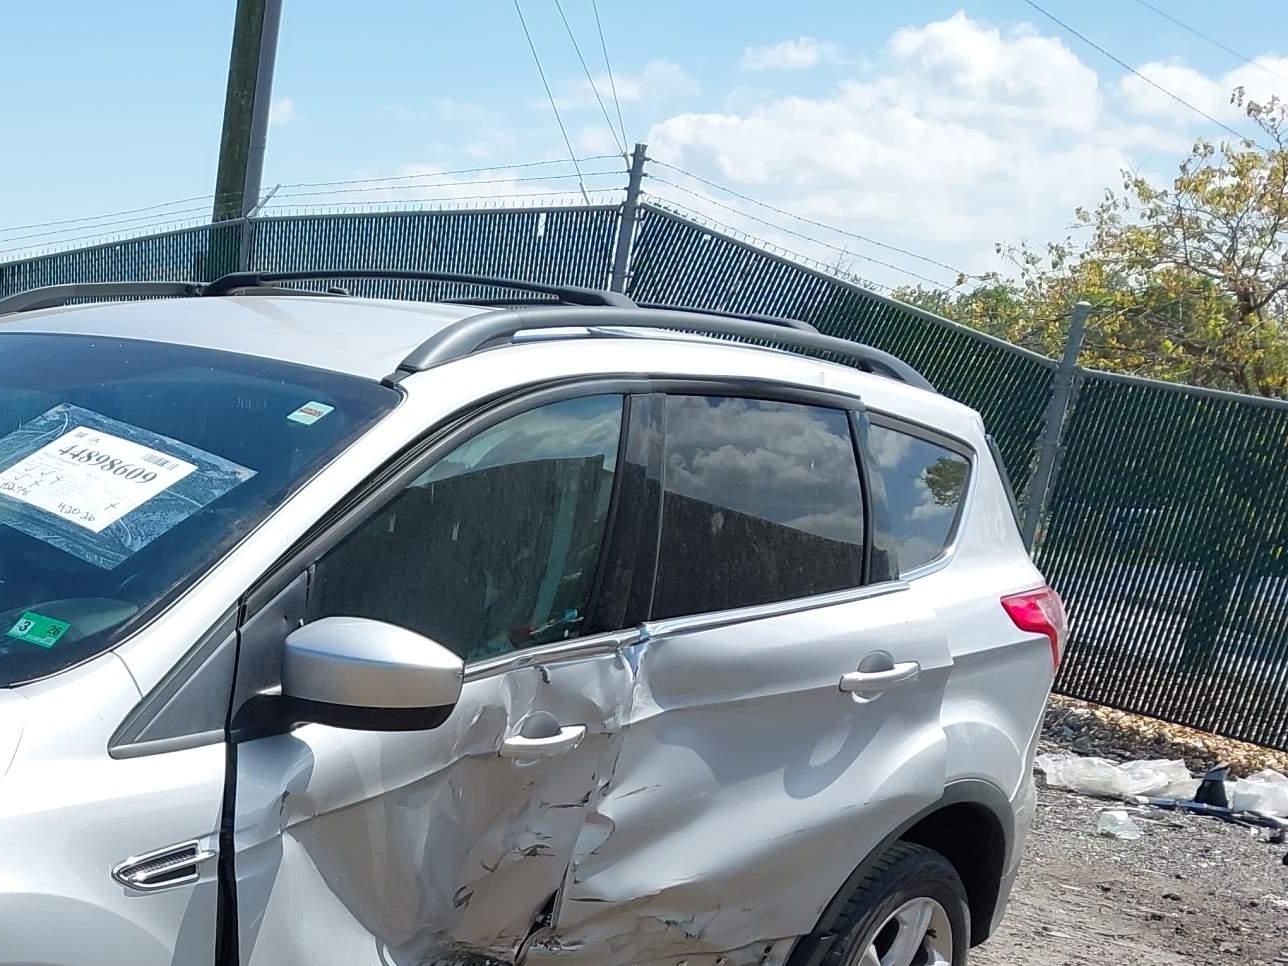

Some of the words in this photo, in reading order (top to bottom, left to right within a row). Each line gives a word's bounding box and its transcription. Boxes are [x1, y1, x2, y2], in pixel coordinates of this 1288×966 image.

[58, 444, 158, 484] 44898609
[18, 620, 32, 631] 3
[46, 624, 62, 636] 26
